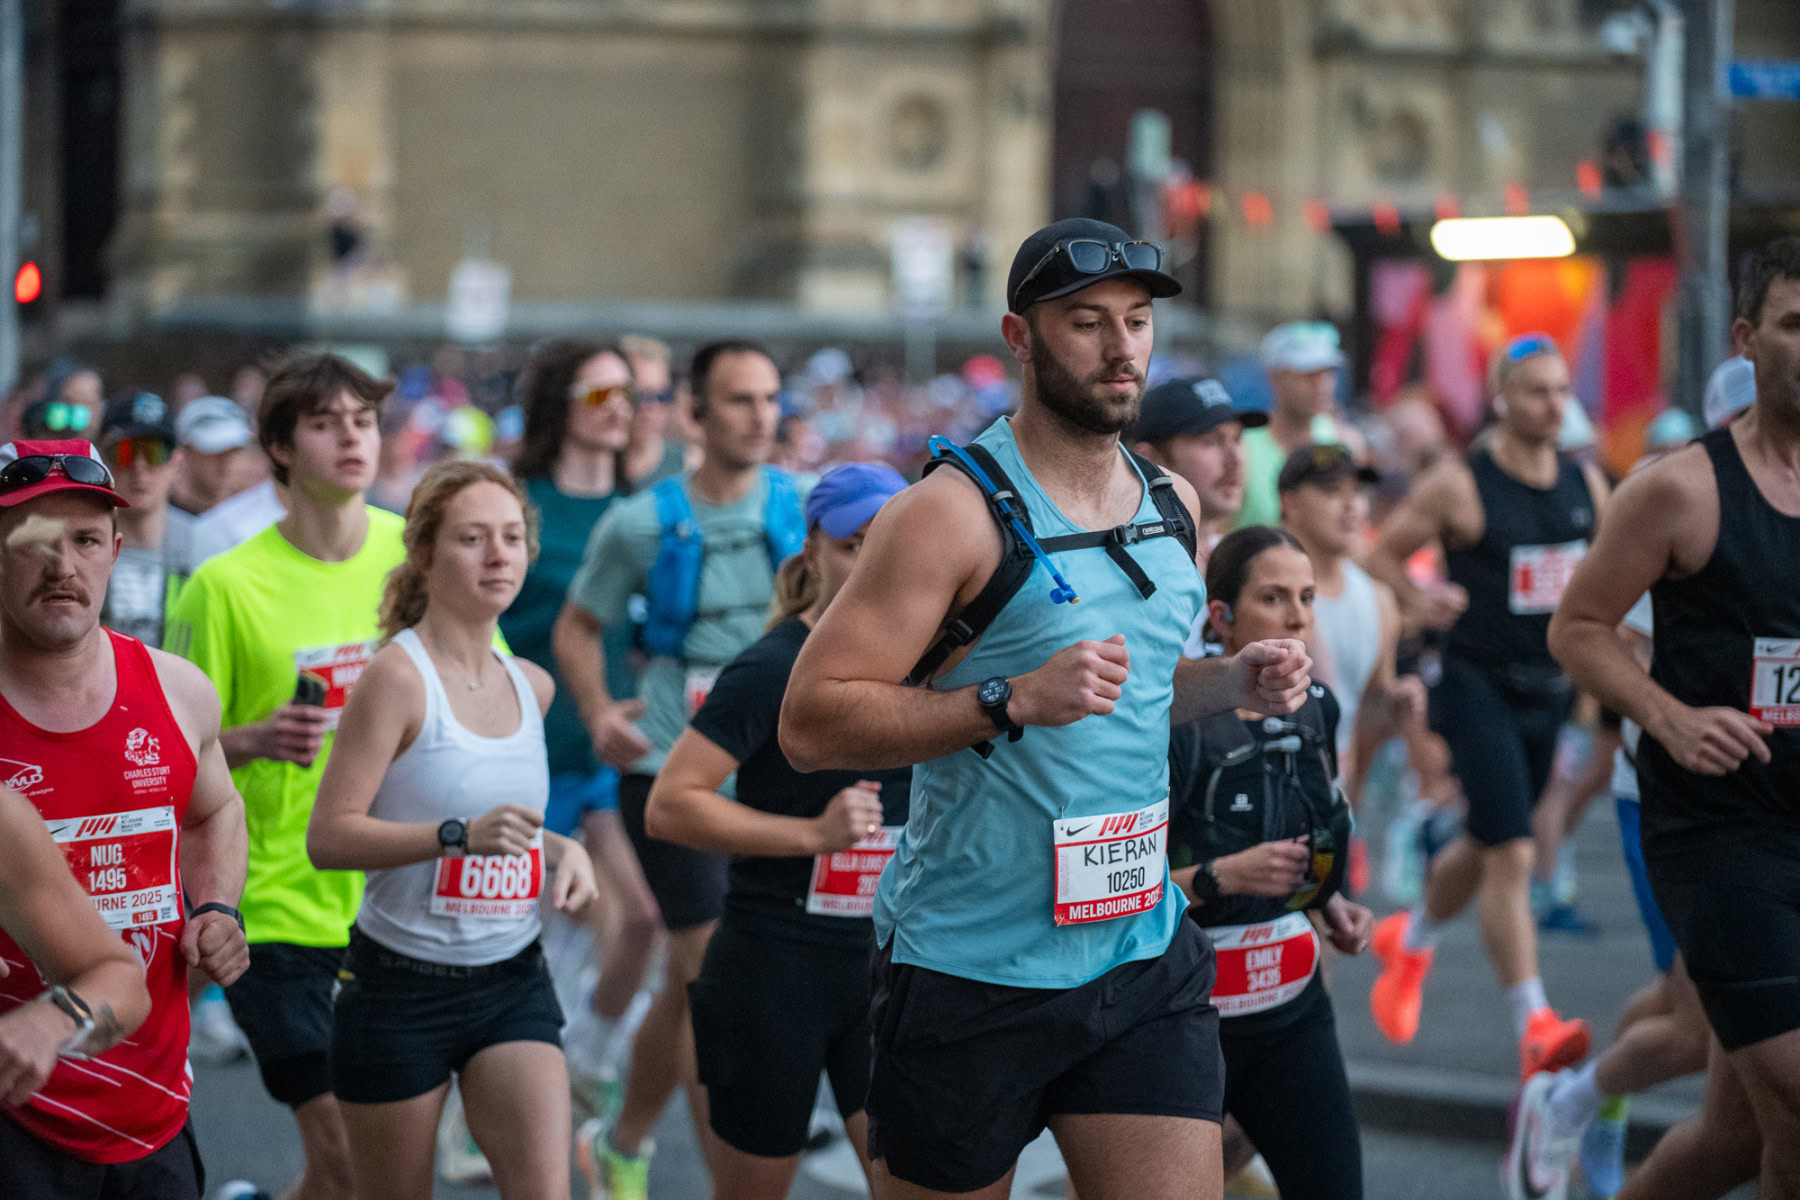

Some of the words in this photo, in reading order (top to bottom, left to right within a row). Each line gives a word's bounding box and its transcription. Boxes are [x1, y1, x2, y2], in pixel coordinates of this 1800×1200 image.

[124, 768, 152, 780] CHARLES
[132, 776, 167, 788] UNIVERSITY
[91, 843, 122, 867] NUG
[1084, 833, 1156, 866] KIERAN
[88, 868, 126, 892] 1495
[461, 852, 532, 898] 6668
[1107, 866, 1145, 894] 10250
[132, 889, 162, 907] 2025
[1069, 896, 1141, 920] MELBOURNE
[1245, 945, 1284, 971] EMILY
